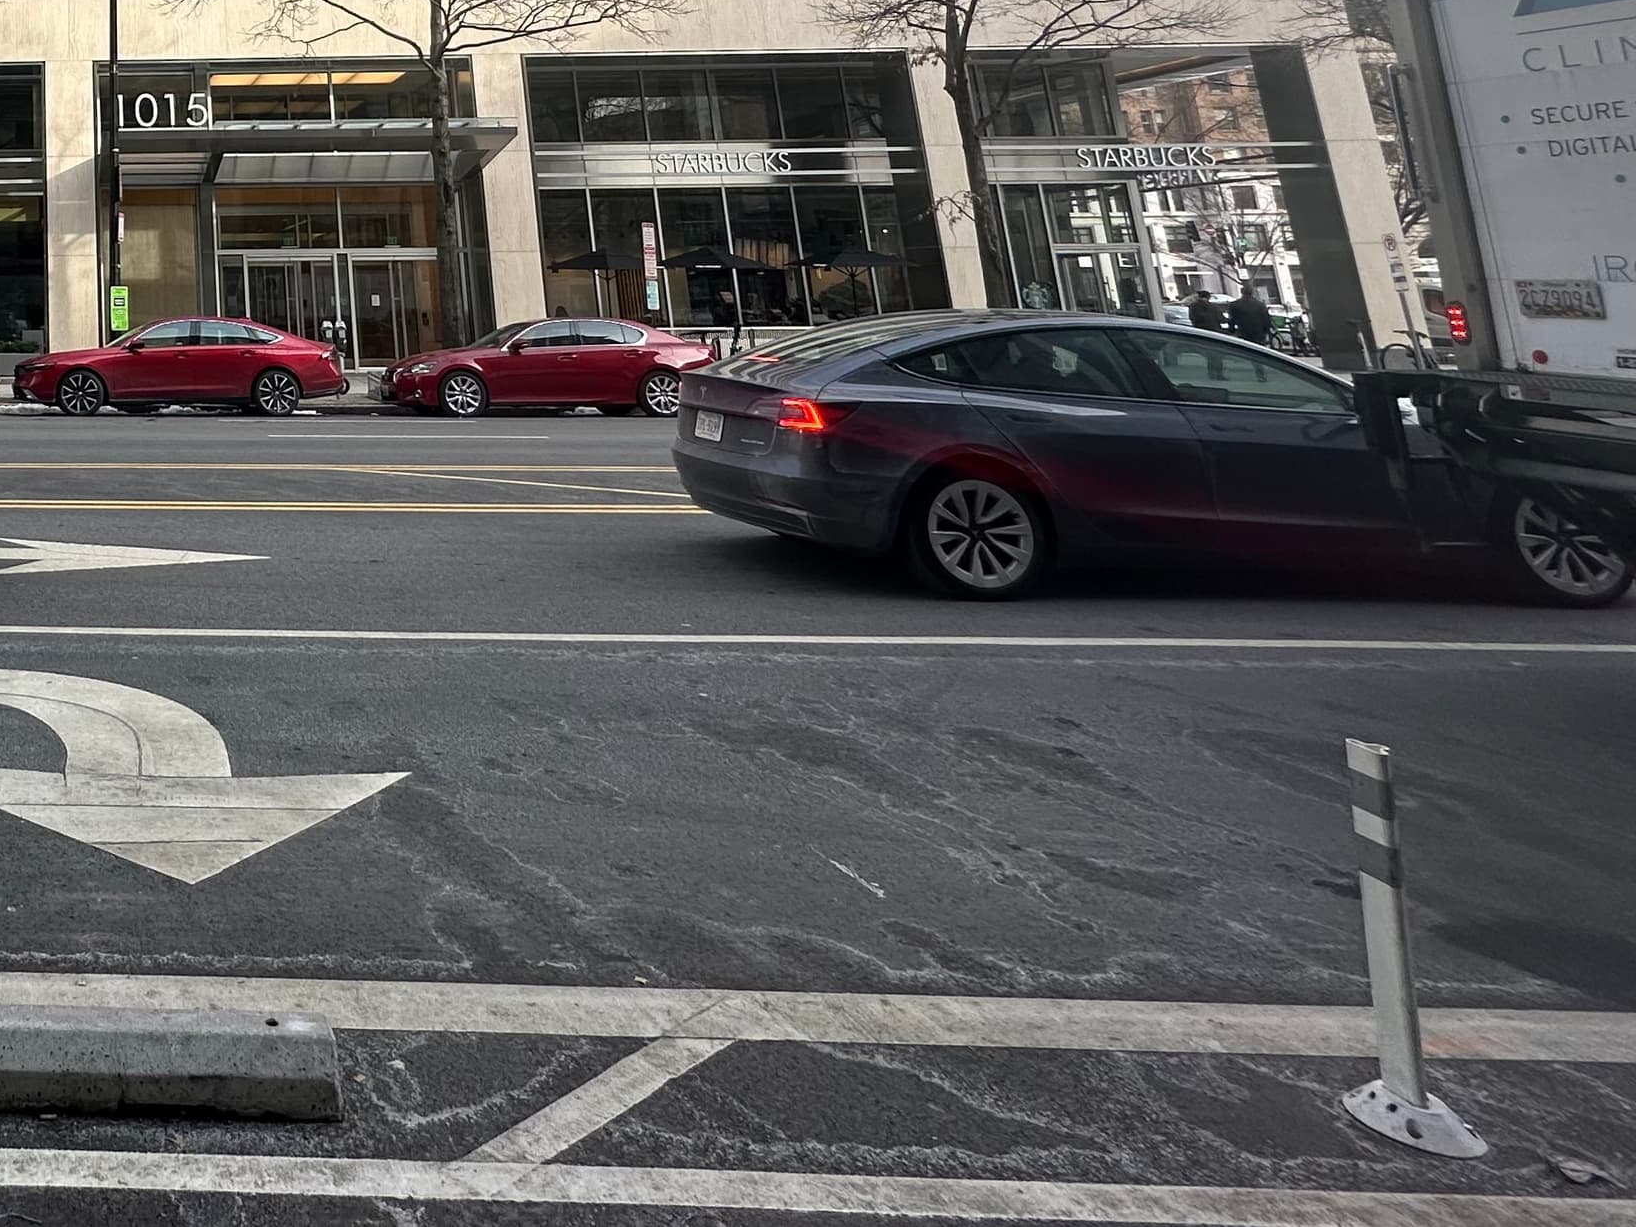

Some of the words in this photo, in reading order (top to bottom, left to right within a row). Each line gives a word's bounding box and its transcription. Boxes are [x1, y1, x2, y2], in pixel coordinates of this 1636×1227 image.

[117, 93, 208, 127] 1015
[1531, 101, 1630, 125] SECURE
[656, 152, 792, 174] STARBUCKS
[1076, 146, 1217, 168] STARBUCKS
[1592, 254, 1636, 282] IR
